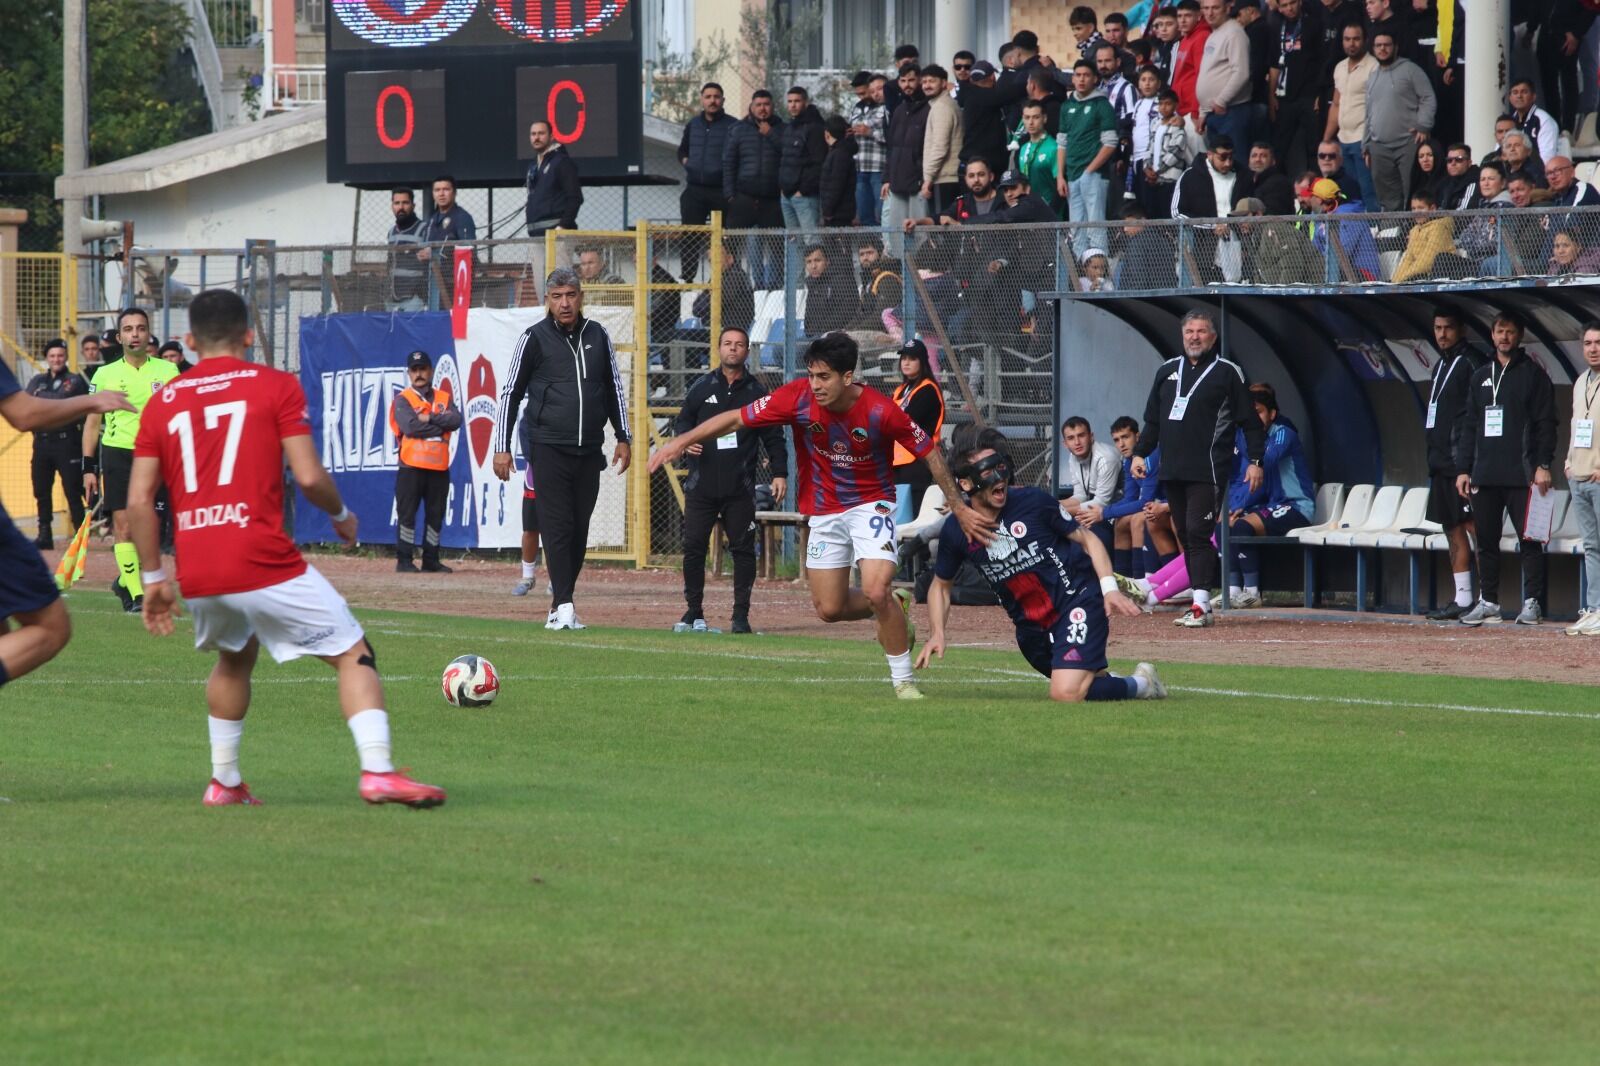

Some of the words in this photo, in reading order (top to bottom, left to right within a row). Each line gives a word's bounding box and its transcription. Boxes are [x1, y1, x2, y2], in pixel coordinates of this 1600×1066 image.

[376, 85, 414, 149] 0
[547, 80, 586, 144] 0
[168, 400, 247, 494] 17
[321, 367, 408, 473] KUZE
[176, 502, 250, 531] YILDIZAÇ
[869, 515, 894, 540] 99
[1066, 623, 1088, 645] 33
